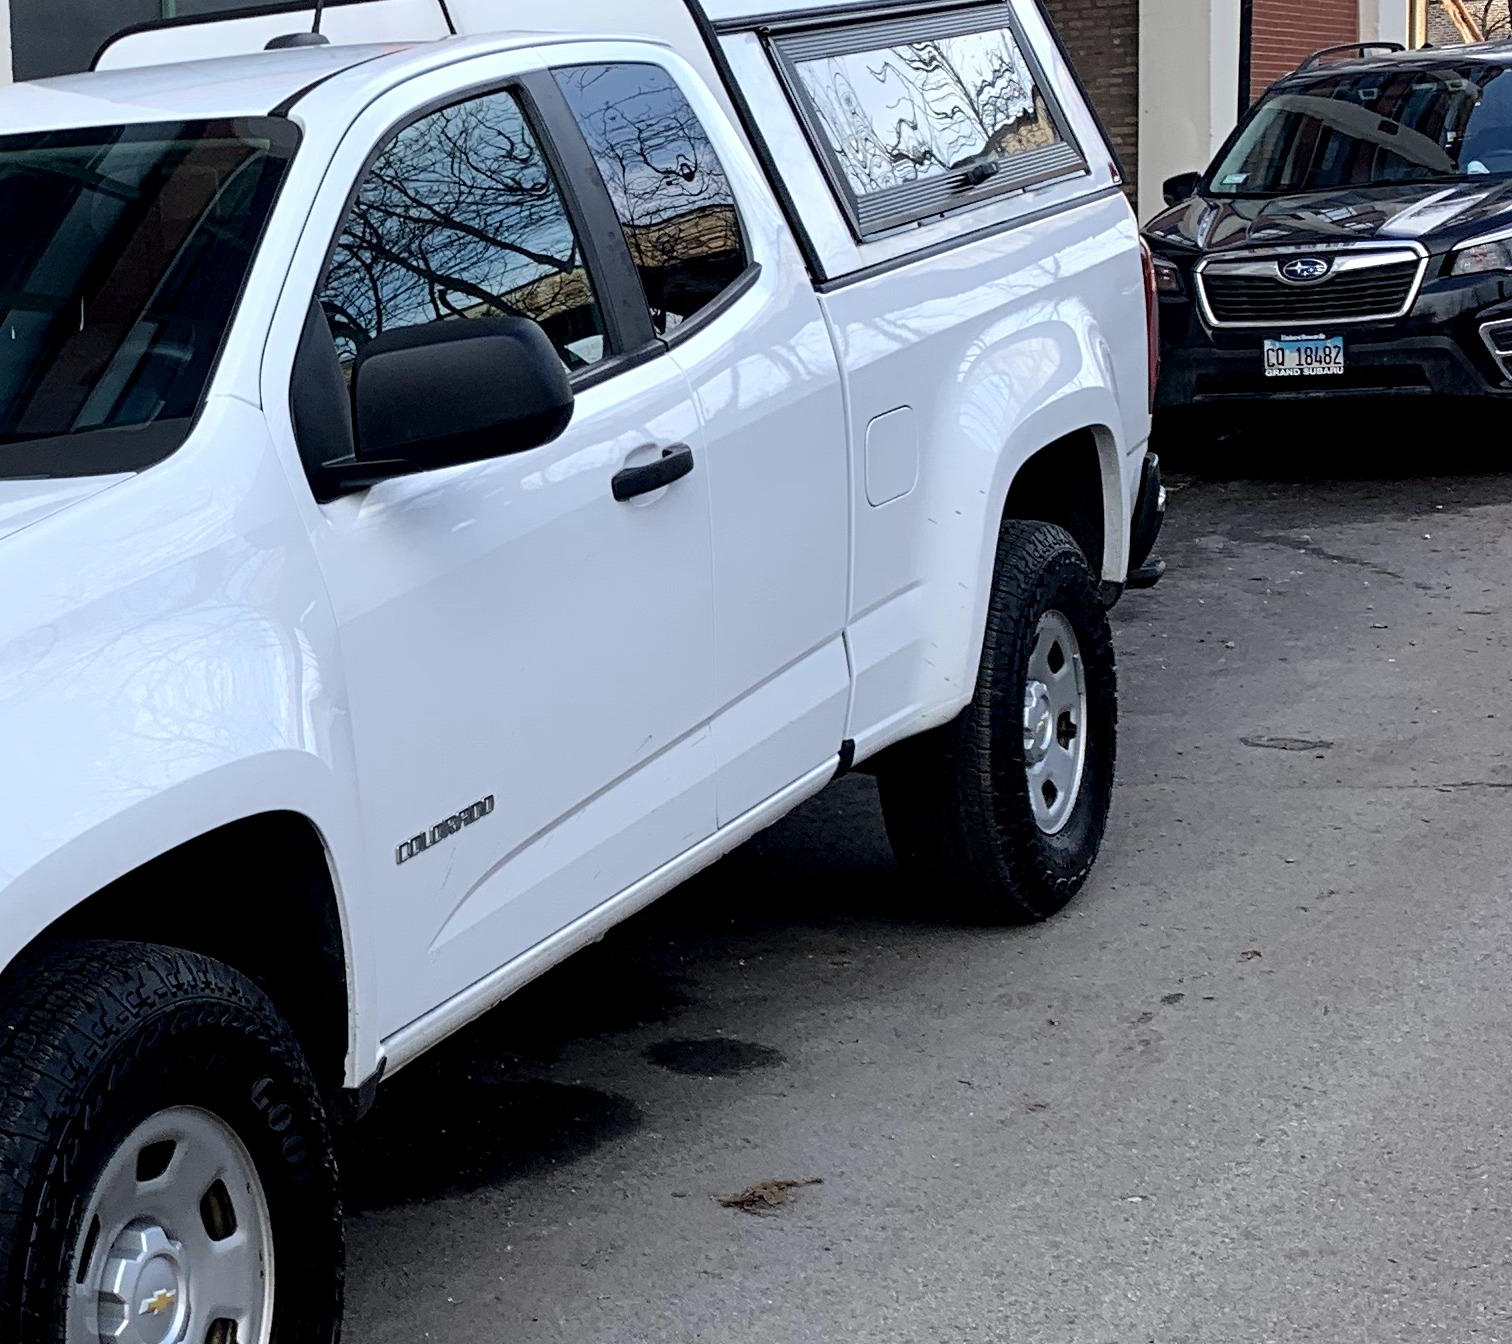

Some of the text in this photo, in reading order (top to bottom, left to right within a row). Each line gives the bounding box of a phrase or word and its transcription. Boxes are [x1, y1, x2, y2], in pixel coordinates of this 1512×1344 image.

[1266, 344, 1342, 367] CQ 18482
[1265, 366, 1344, 377] GRAND SUBARU
[395, 794, 495, 865] COLORADO
